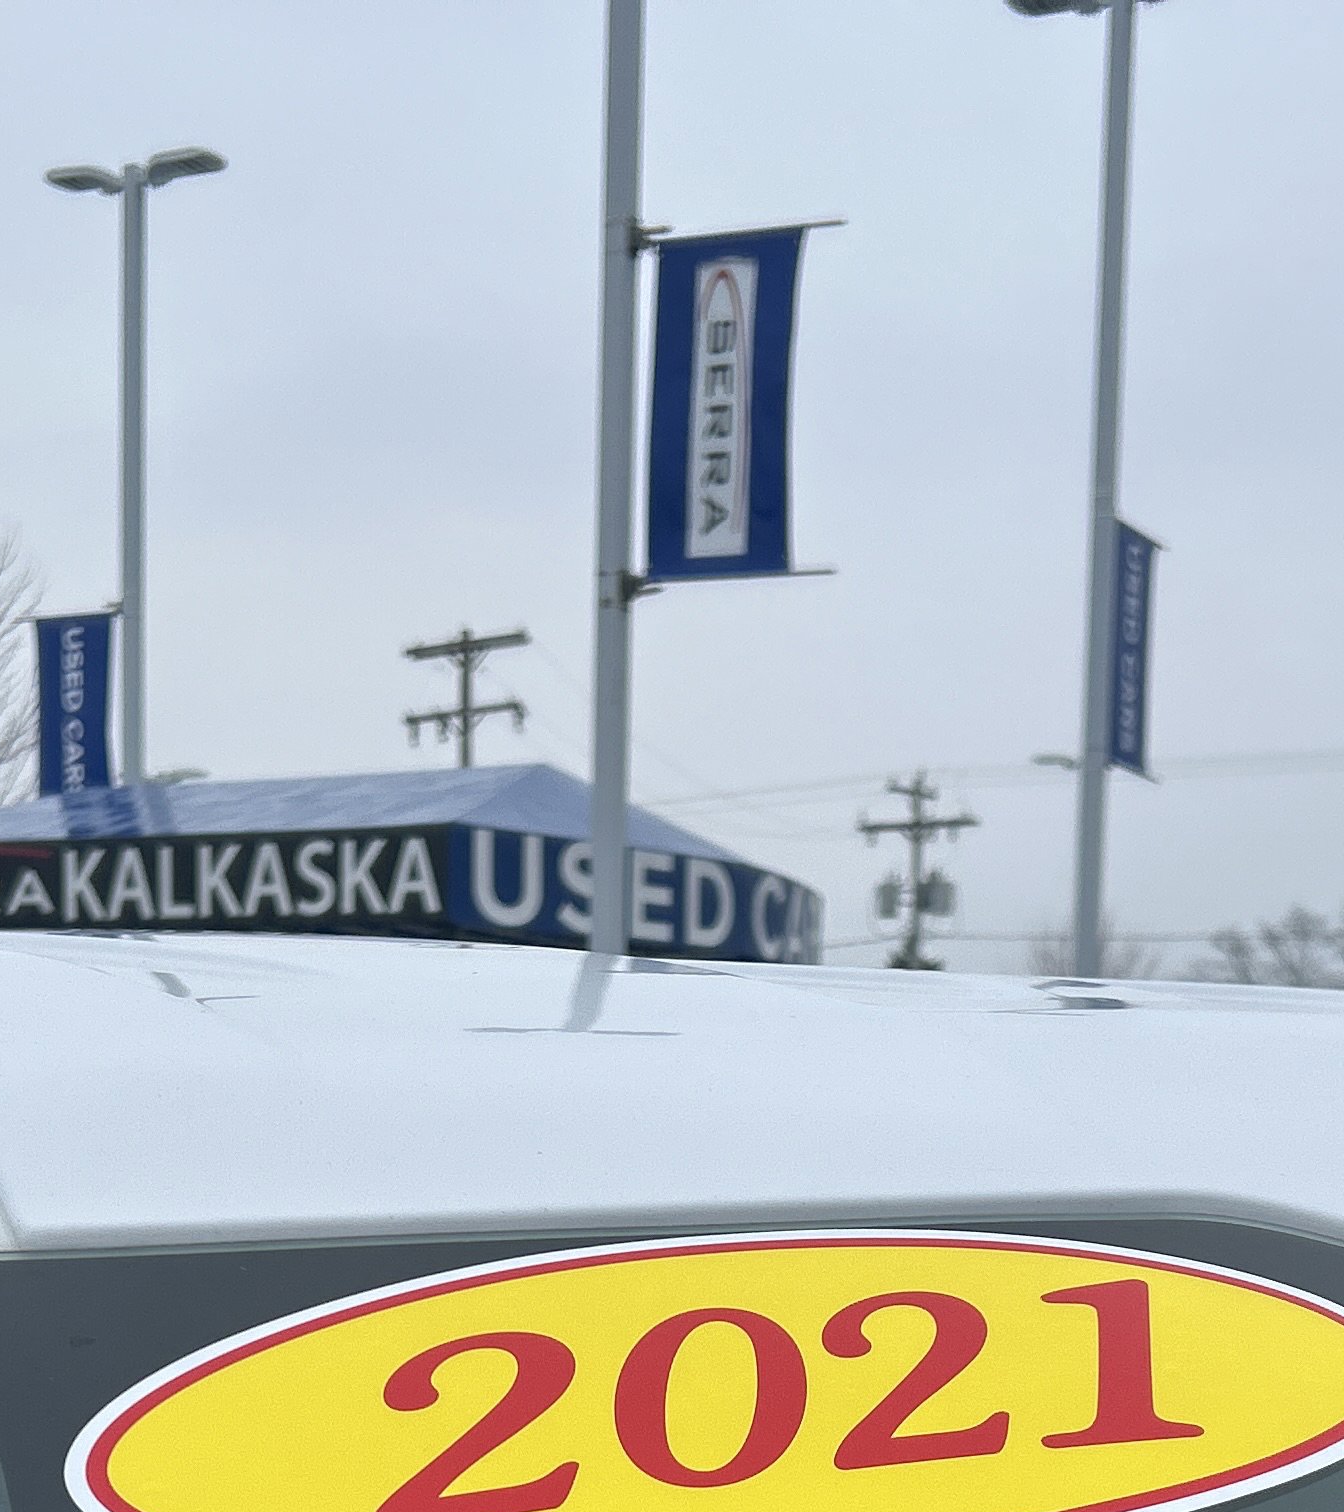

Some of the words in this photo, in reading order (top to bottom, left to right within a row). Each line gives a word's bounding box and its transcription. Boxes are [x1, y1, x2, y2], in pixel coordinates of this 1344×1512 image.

[699, 318, 737, 537] SERRA
[60, 626, 85, 713] USED
[62, 836, 444, 923] KALKASKA
[470, 828, 736, 949] USED
